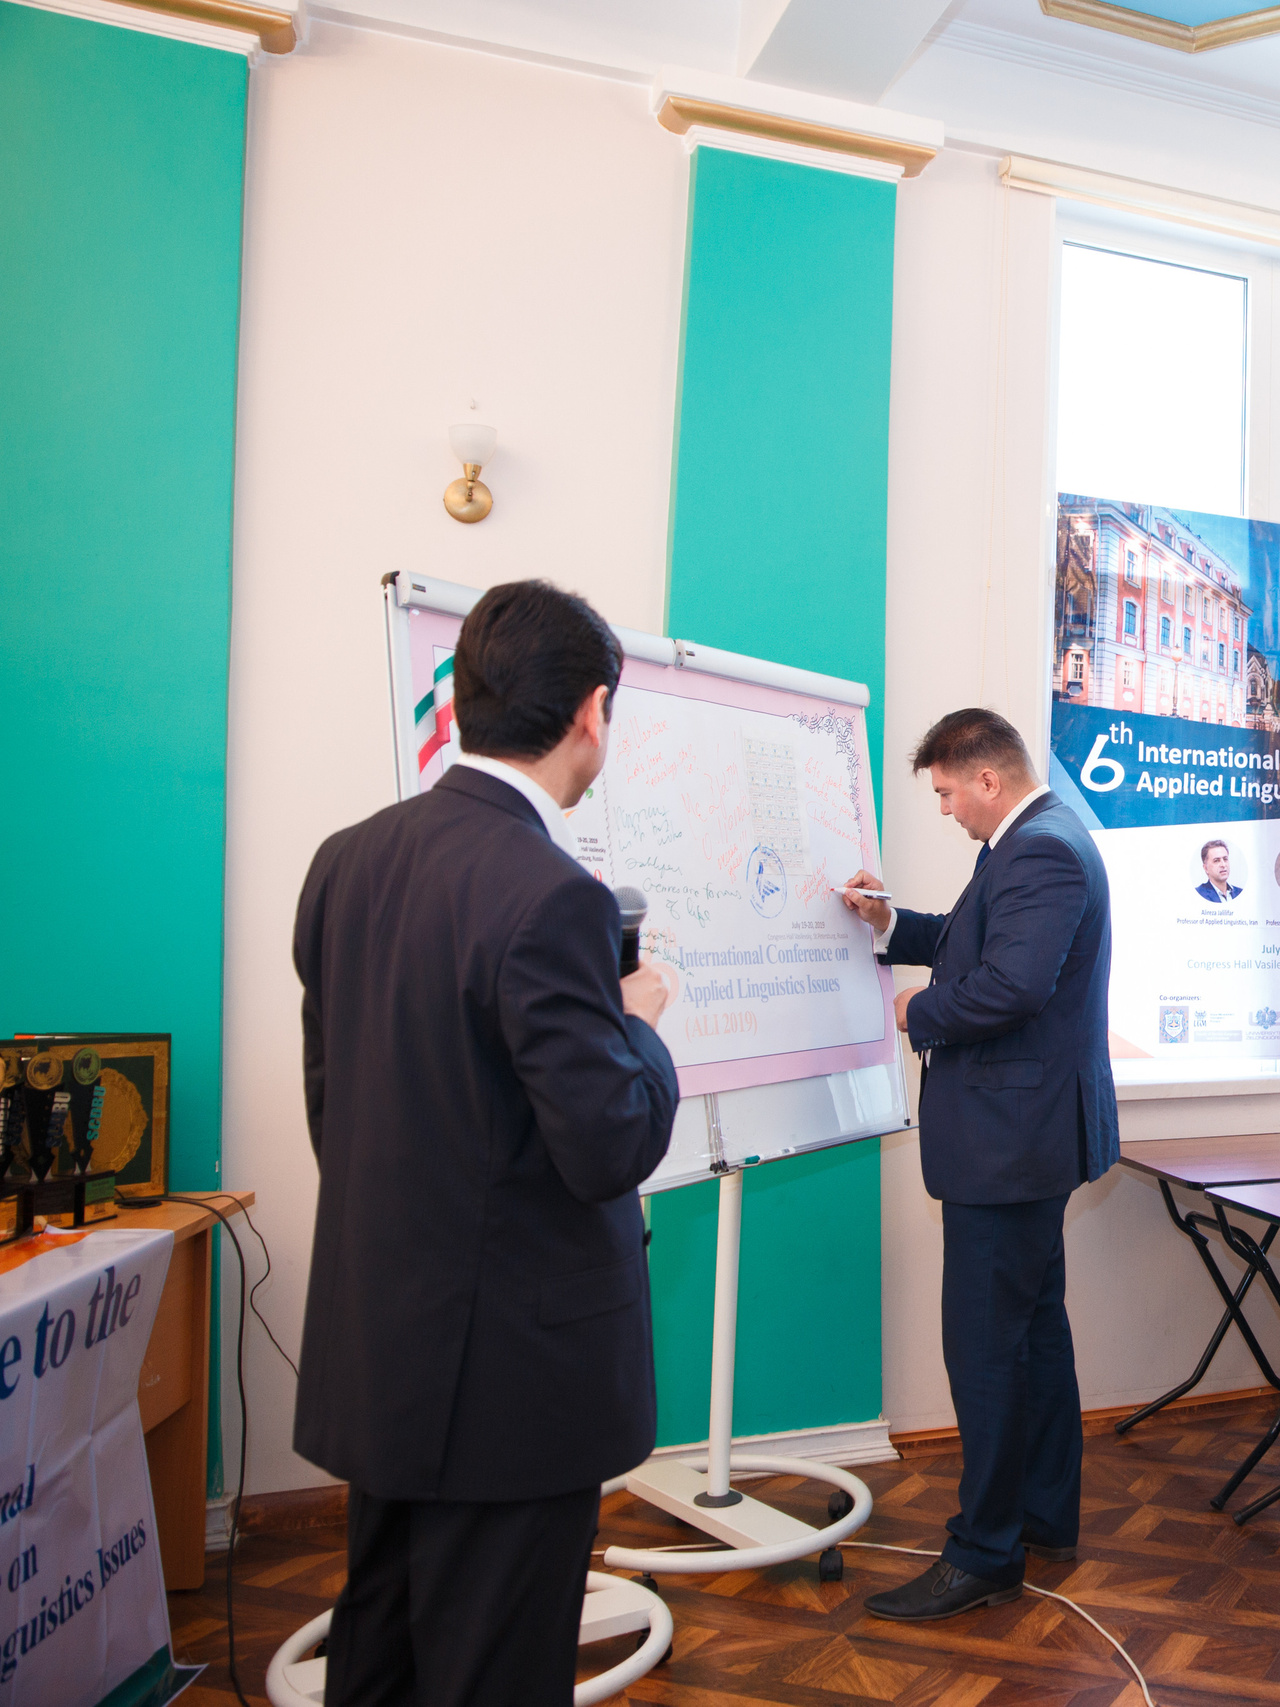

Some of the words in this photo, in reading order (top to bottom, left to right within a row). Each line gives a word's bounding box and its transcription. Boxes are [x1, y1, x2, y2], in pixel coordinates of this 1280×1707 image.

[1138, 740, 1280, 771] International
[1136, 771, 1223, 799] Applied
[1176, 918, 1199, 926] Professor
[1199, 918, 1205, 926] of
[1205, 918, 1222, 926] Applied
[678, 944, 764, 968] International
[766, 943, 833, 964] Conference
[835, 947, 850, 962] on
[1187, 959, 1231, 971] Congress
[1234, 960, 1252, 969] Hall
[1262, 944, 1280, 956] July
[683, 979, 734, 1008] Applied
[736, 976, 806, 1003] Linguistics
[806, 974, 841, 994] Issues
[685, 1014, 720, 1042] (ALI
[722, 1010, 758, 1036] 2019)
[33, 1301, 76, 1379] to
[85, 1265, 141, 1350] the
[8, 1544, 39, 1593] on
[0, 1570, 95, 1684] guistics
[96, 1518, 147, 1591] Issues
